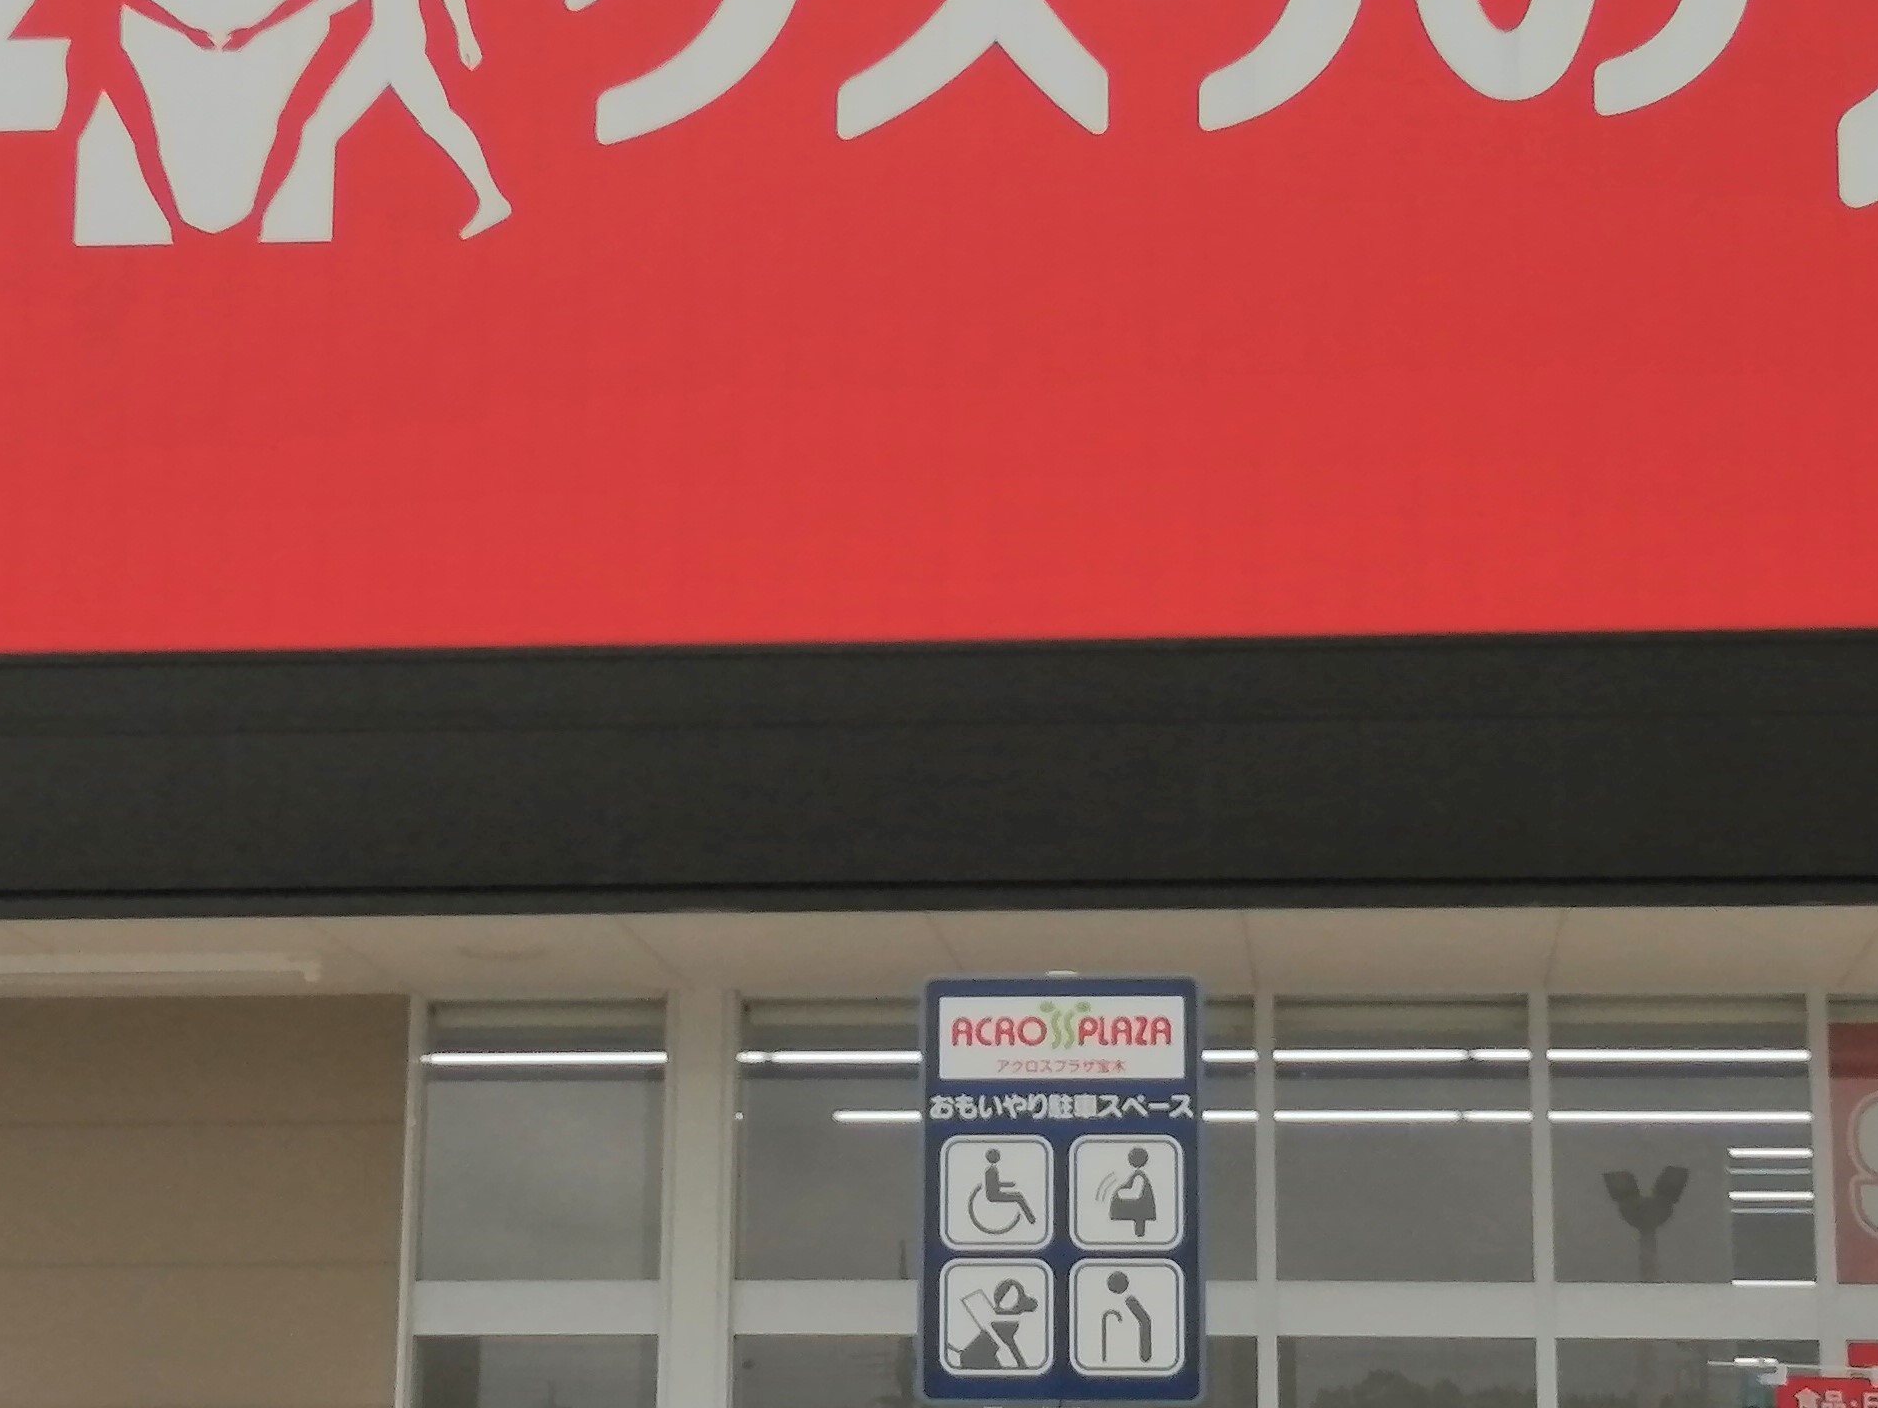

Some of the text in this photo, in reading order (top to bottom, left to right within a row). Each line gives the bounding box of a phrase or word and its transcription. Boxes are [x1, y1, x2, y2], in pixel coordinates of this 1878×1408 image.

[1078, 1016, 1173, 1047] PLAZA
[929, 1093, 1195, 1120] おもいやり駐車スペース
